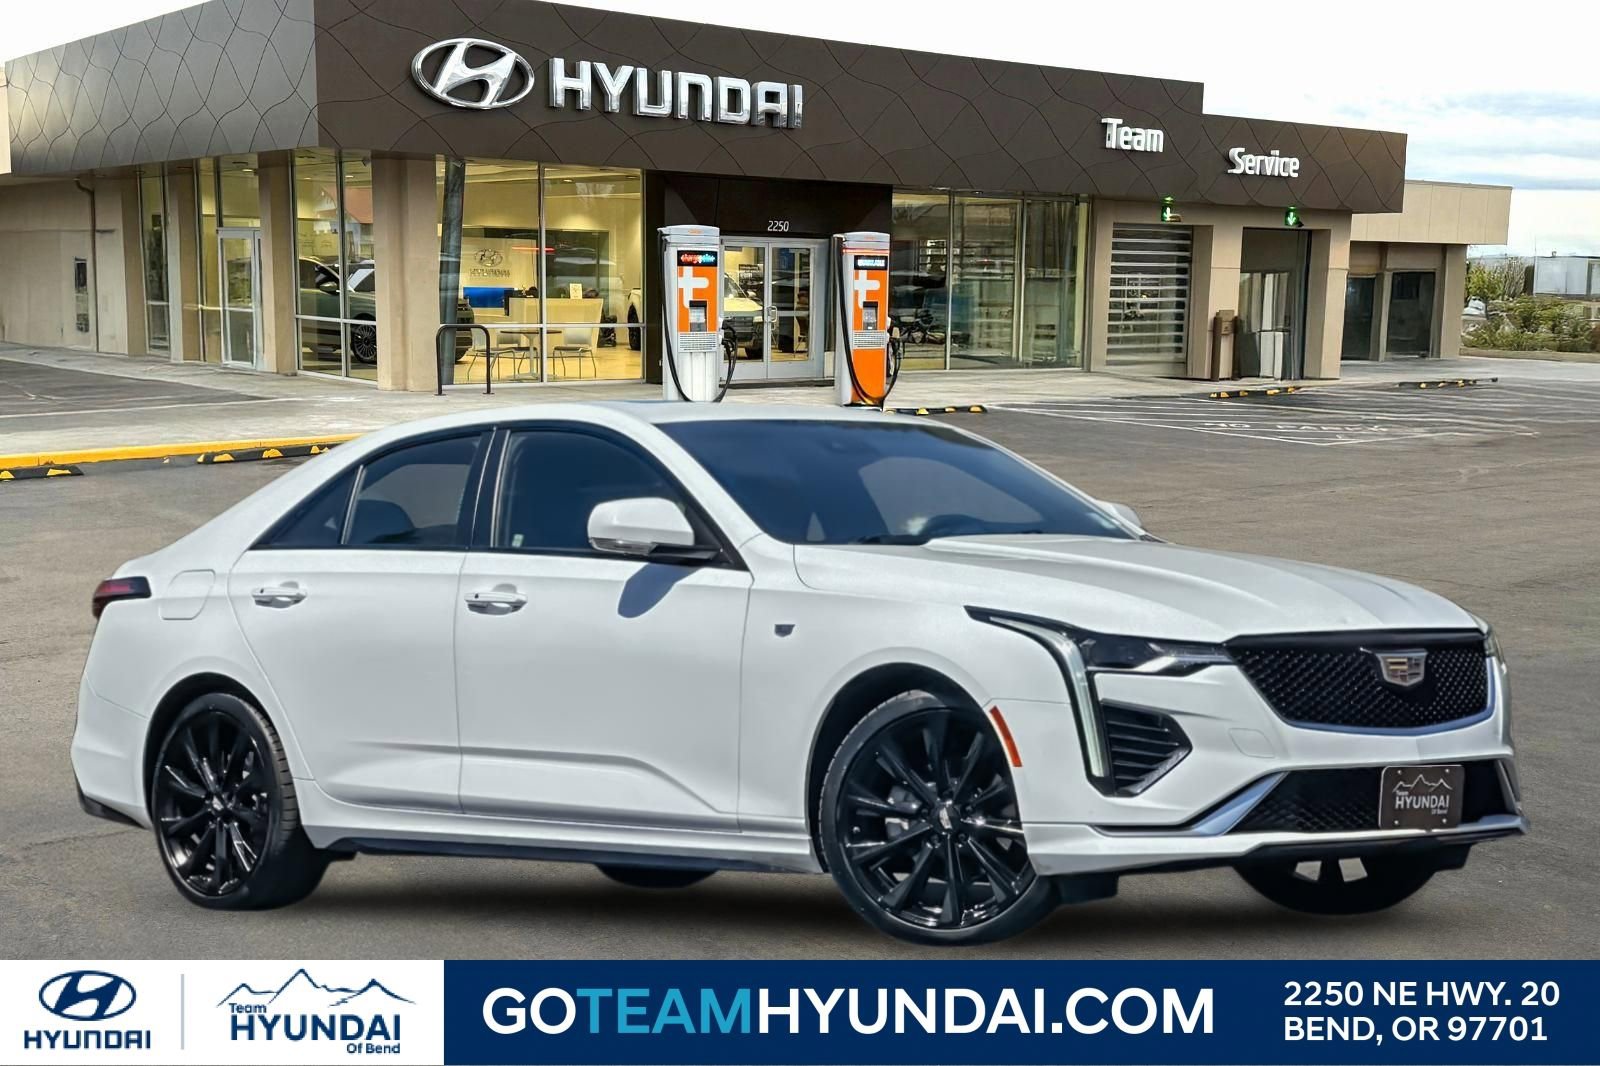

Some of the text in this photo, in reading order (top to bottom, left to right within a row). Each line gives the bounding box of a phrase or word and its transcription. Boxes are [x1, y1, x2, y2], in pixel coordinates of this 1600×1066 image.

[549, 57, 803, 129] HYUNDAI
[1101, 117, 1163, 152] Team
[1227, 147, 1299, 178] Service
[767, 220, 789, 232] 2250
[1395, 795, 1449, 809] HYUNDAI
